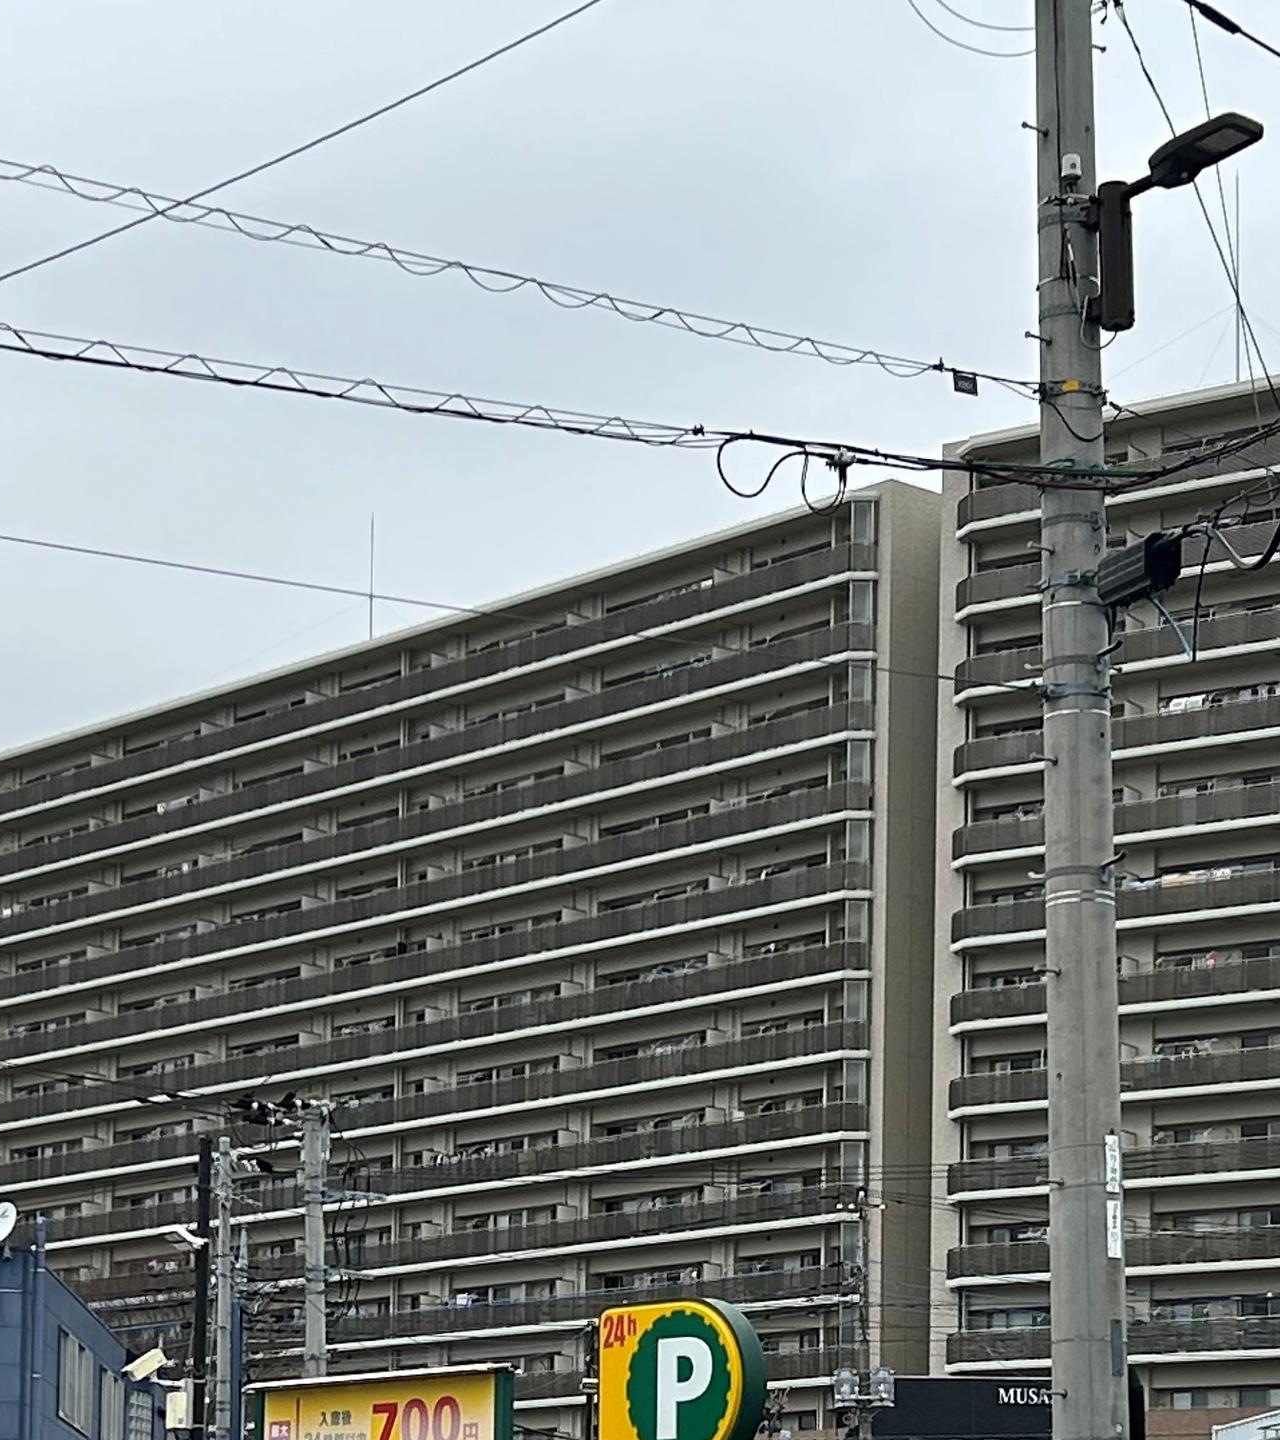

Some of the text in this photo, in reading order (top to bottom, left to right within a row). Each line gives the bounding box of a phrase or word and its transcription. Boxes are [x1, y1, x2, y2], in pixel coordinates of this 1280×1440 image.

[603, 1313, 637, 1348] 24h
[656, 1336, 713, 1440] P
[998, 1387, 1053, 1404] MUSA
